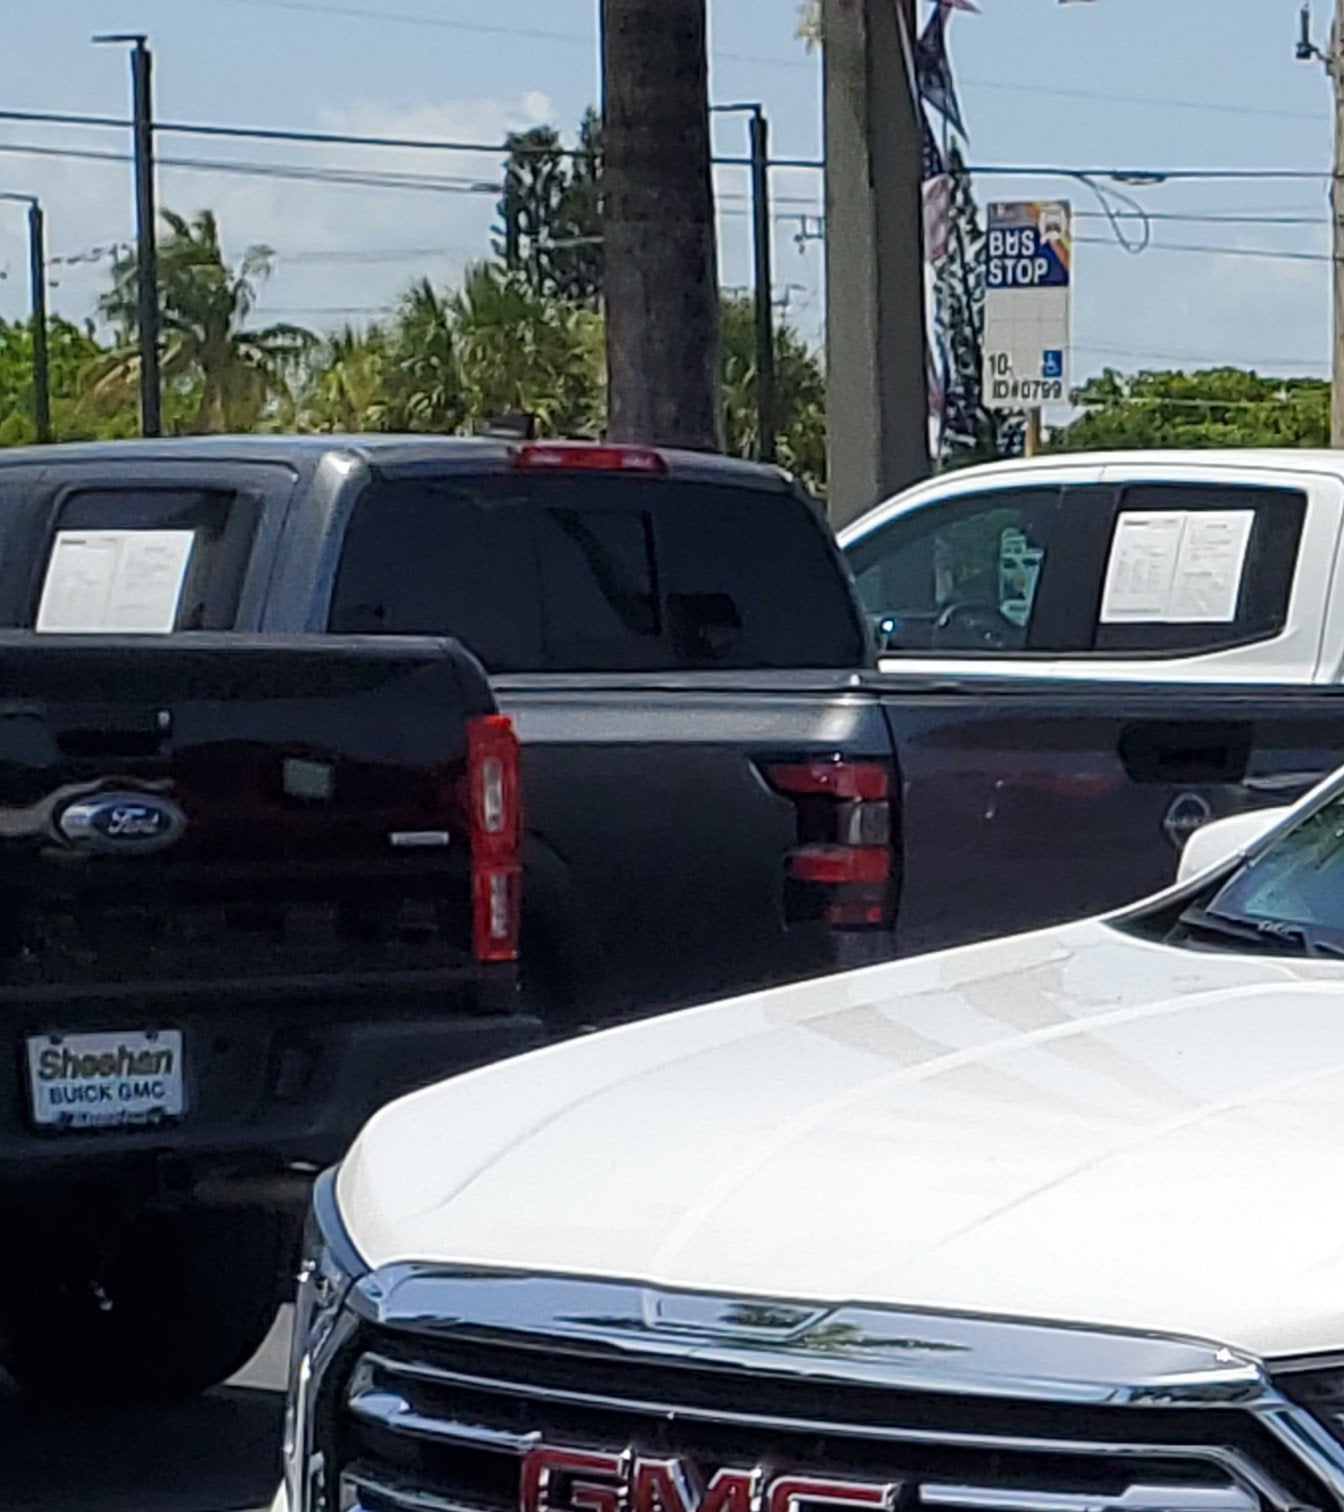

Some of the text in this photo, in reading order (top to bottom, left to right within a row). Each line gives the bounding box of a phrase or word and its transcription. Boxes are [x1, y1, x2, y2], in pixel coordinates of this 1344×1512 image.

[989, 229, 1035, 256] BUS
[987, 257, 1049, 285] STOP
[107, 808, 160, 834] Ford
[38, 1043, 174, 1081] Sheehan
[50, 1080, 166, 1105] BUICK GMC
